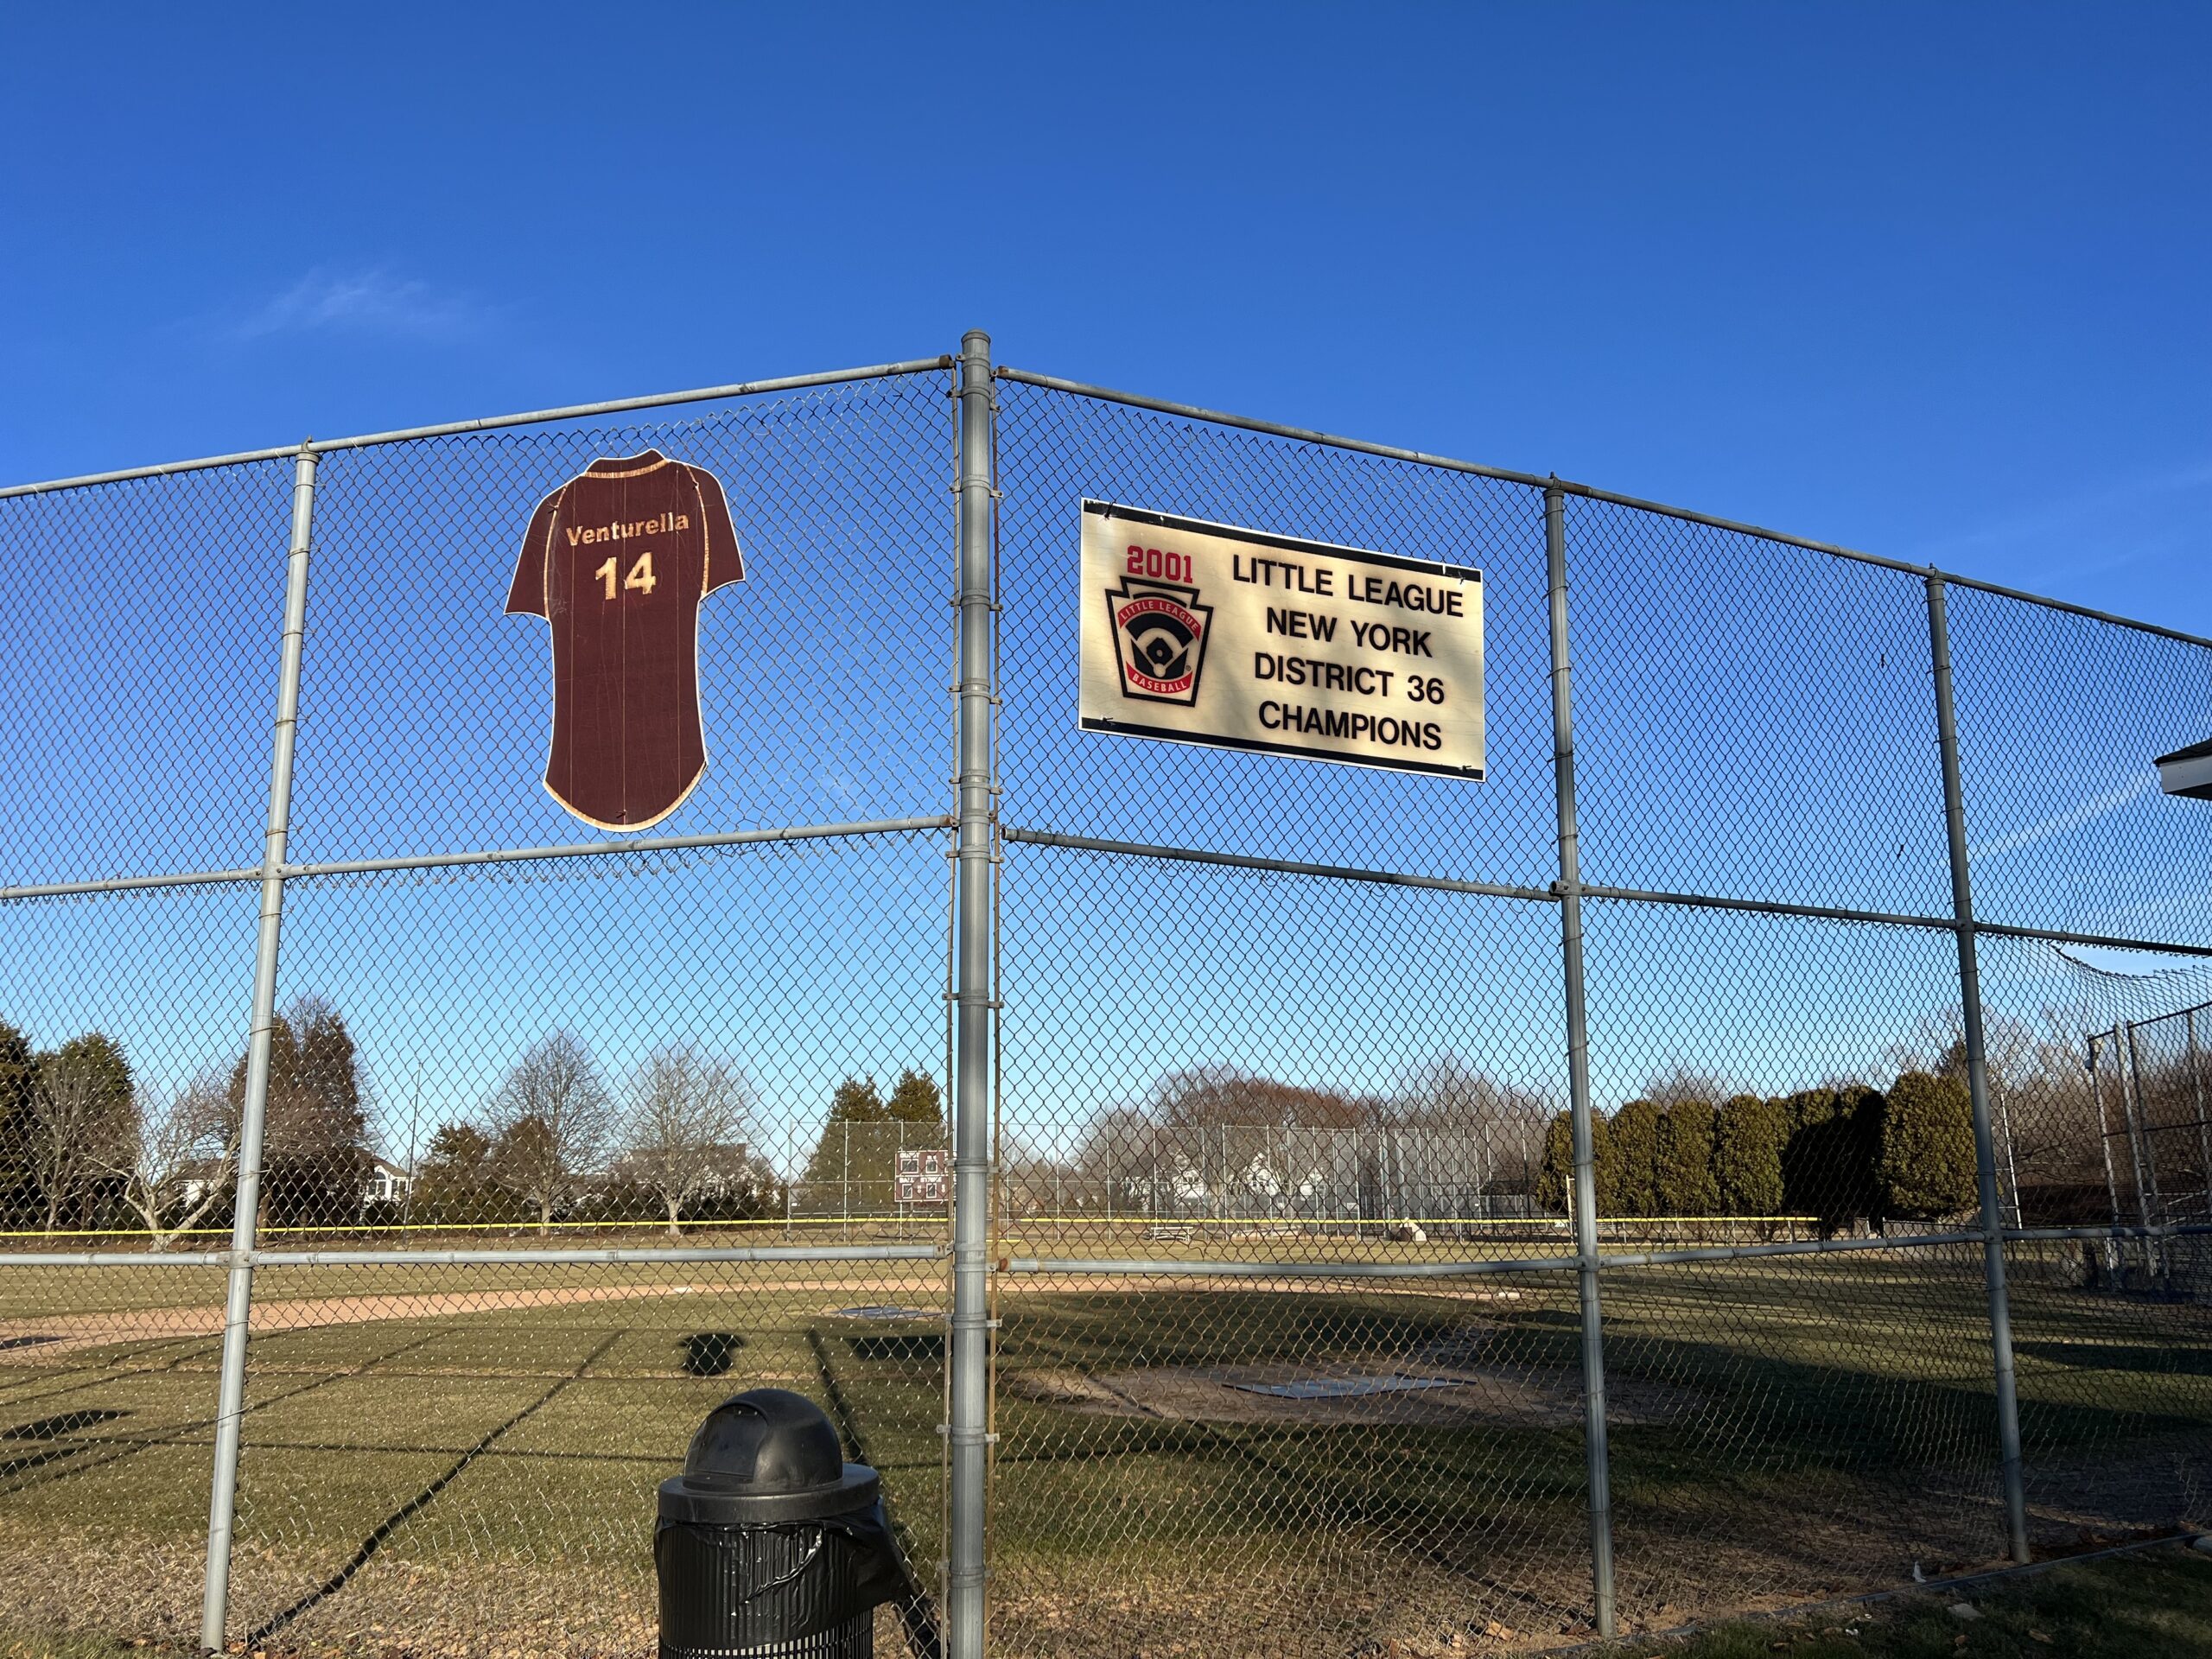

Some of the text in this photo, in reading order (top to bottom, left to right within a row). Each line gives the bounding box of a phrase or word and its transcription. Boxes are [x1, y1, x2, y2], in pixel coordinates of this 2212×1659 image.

[565, 512, 690, 546] Venturella
[594, 551, 657, 601] 14
[1127, 544, 1193, 584] 2001
[1233, 554, 1464, 618] LITTLE LEAGUE
[1119, 600, 1198, 632] LITTLE LEAGUE
[1267, 607, 1433, 658] NEW YORK
[1132, 674, 1187, 692] BASEBALL
[1255, 652, 1446, 705] DISTRICT 36
[1258, 700, 1442, 751] CHAMPIONS
